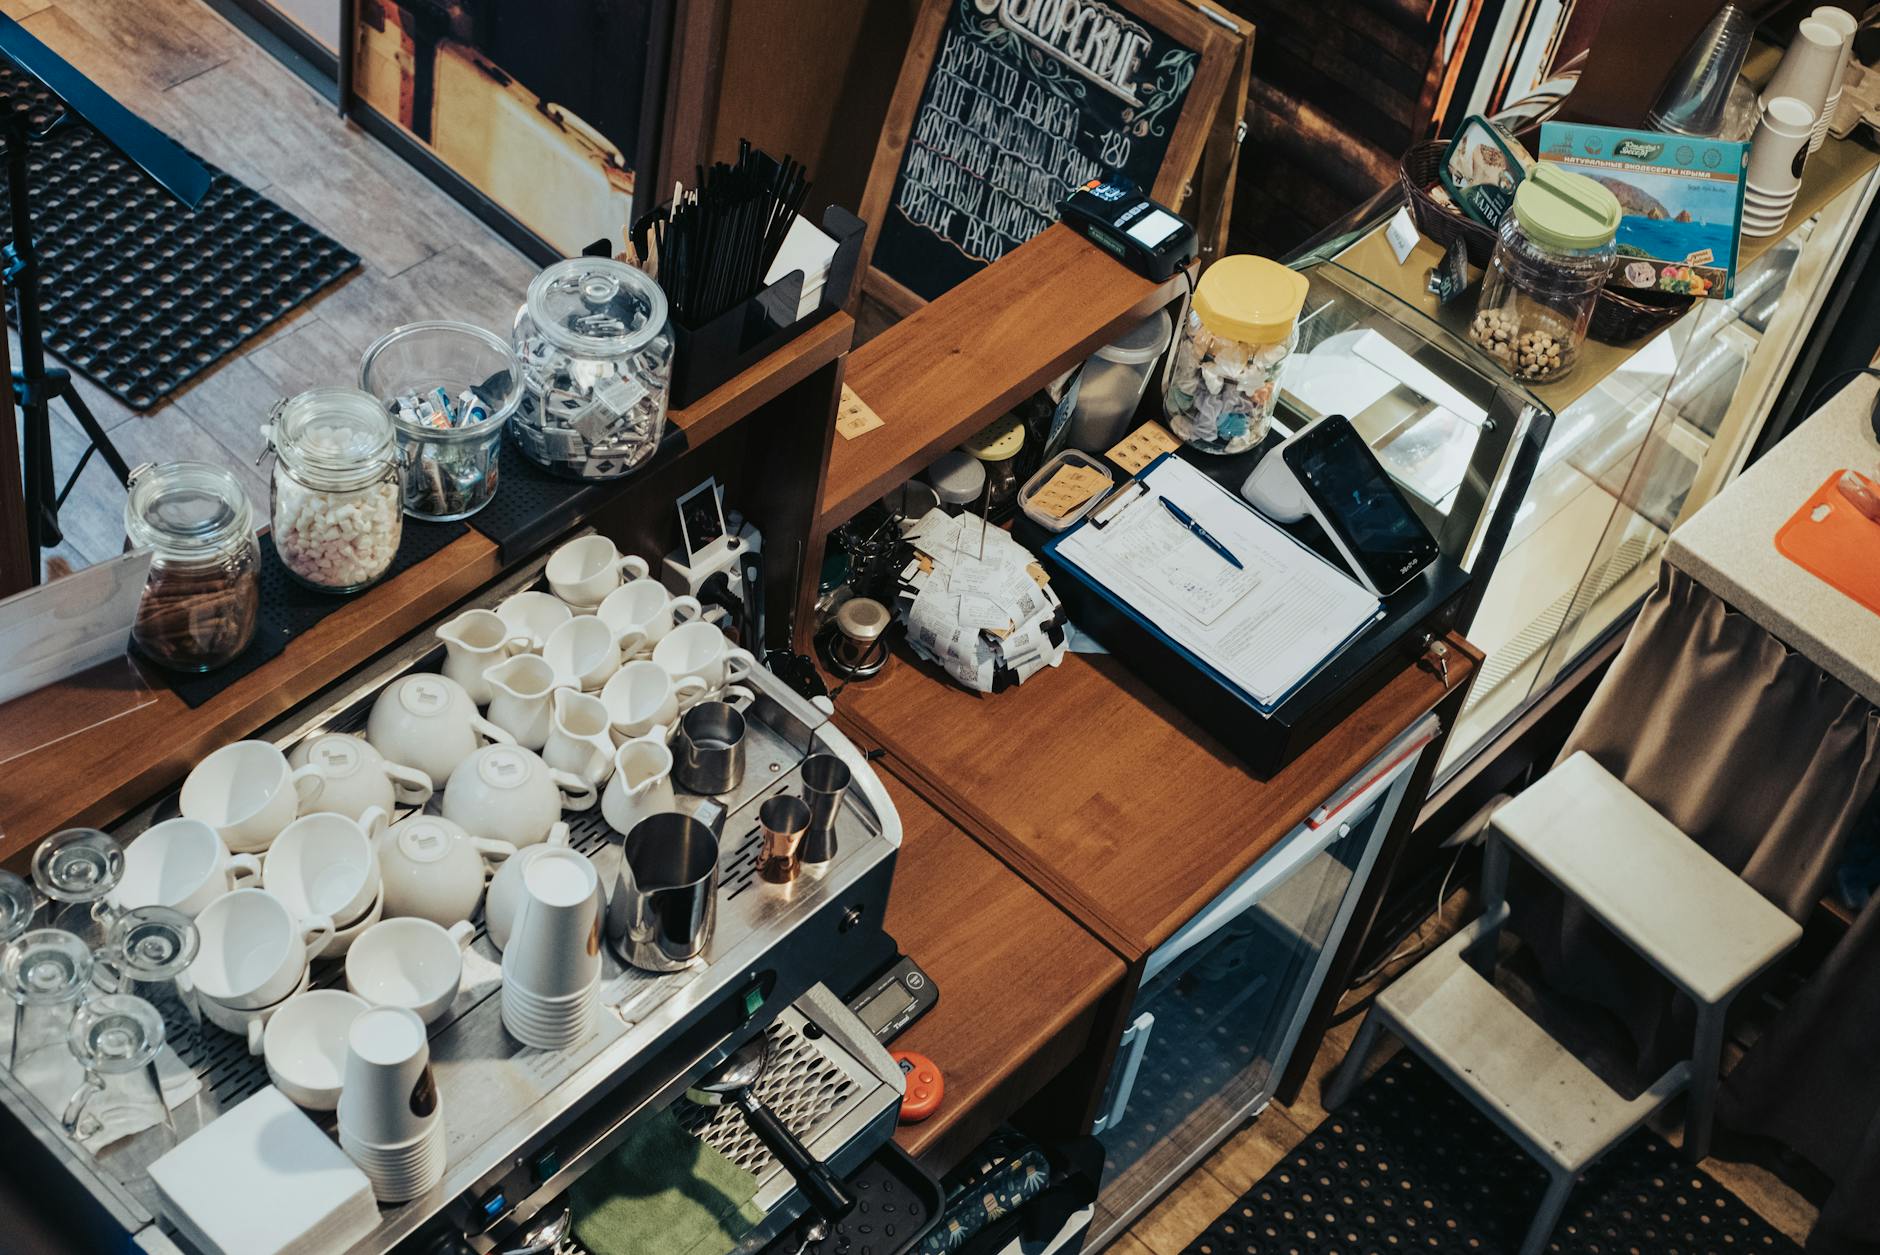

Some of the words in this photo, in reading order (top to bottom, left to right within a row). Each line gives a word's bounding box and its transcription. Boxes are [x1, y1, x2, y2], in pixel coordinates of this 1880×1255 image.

[1019, 80, 1079, 144] БАЙКАЛ
[1100, 129, 1130, 168] 180
[1563, 156, 1623, 169] НАТУРАЛЬНЫЕ
[1624, 163, 1679, 175] ЭКОДЕСЕРТЫ
[1680, 169, 1711, 179] КРЫМА
[1472, 190, 1499, 227] ХАЛВА
